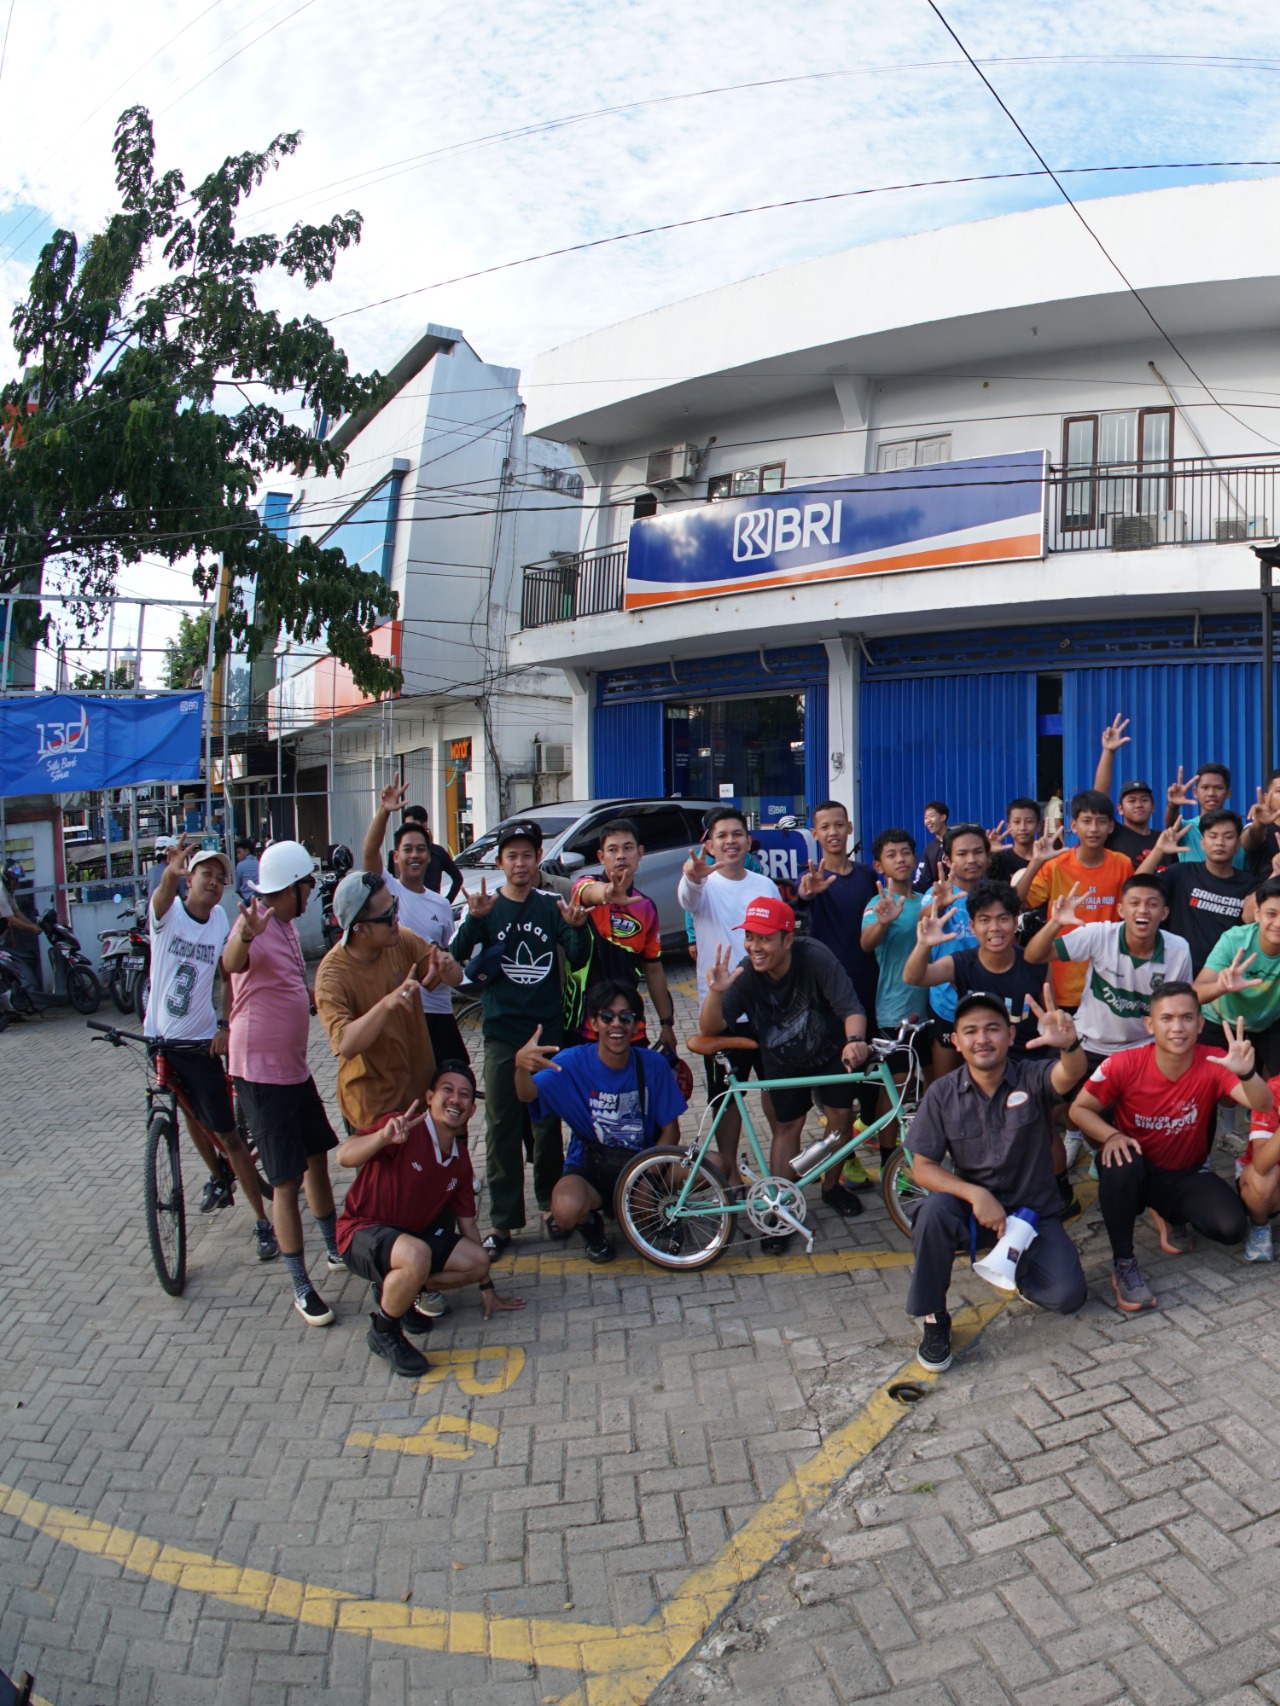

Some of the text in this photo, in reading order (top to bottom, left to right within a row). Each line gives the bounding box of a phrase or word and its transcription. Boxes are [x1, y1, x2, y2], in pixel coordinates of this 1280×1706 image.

[774, 499, 842, 553] BRI
[1189, 897, 1242, 918] RUNNERS
[196, 943, 215, 966] STATE
[164, 960, 200, 1020] 3
